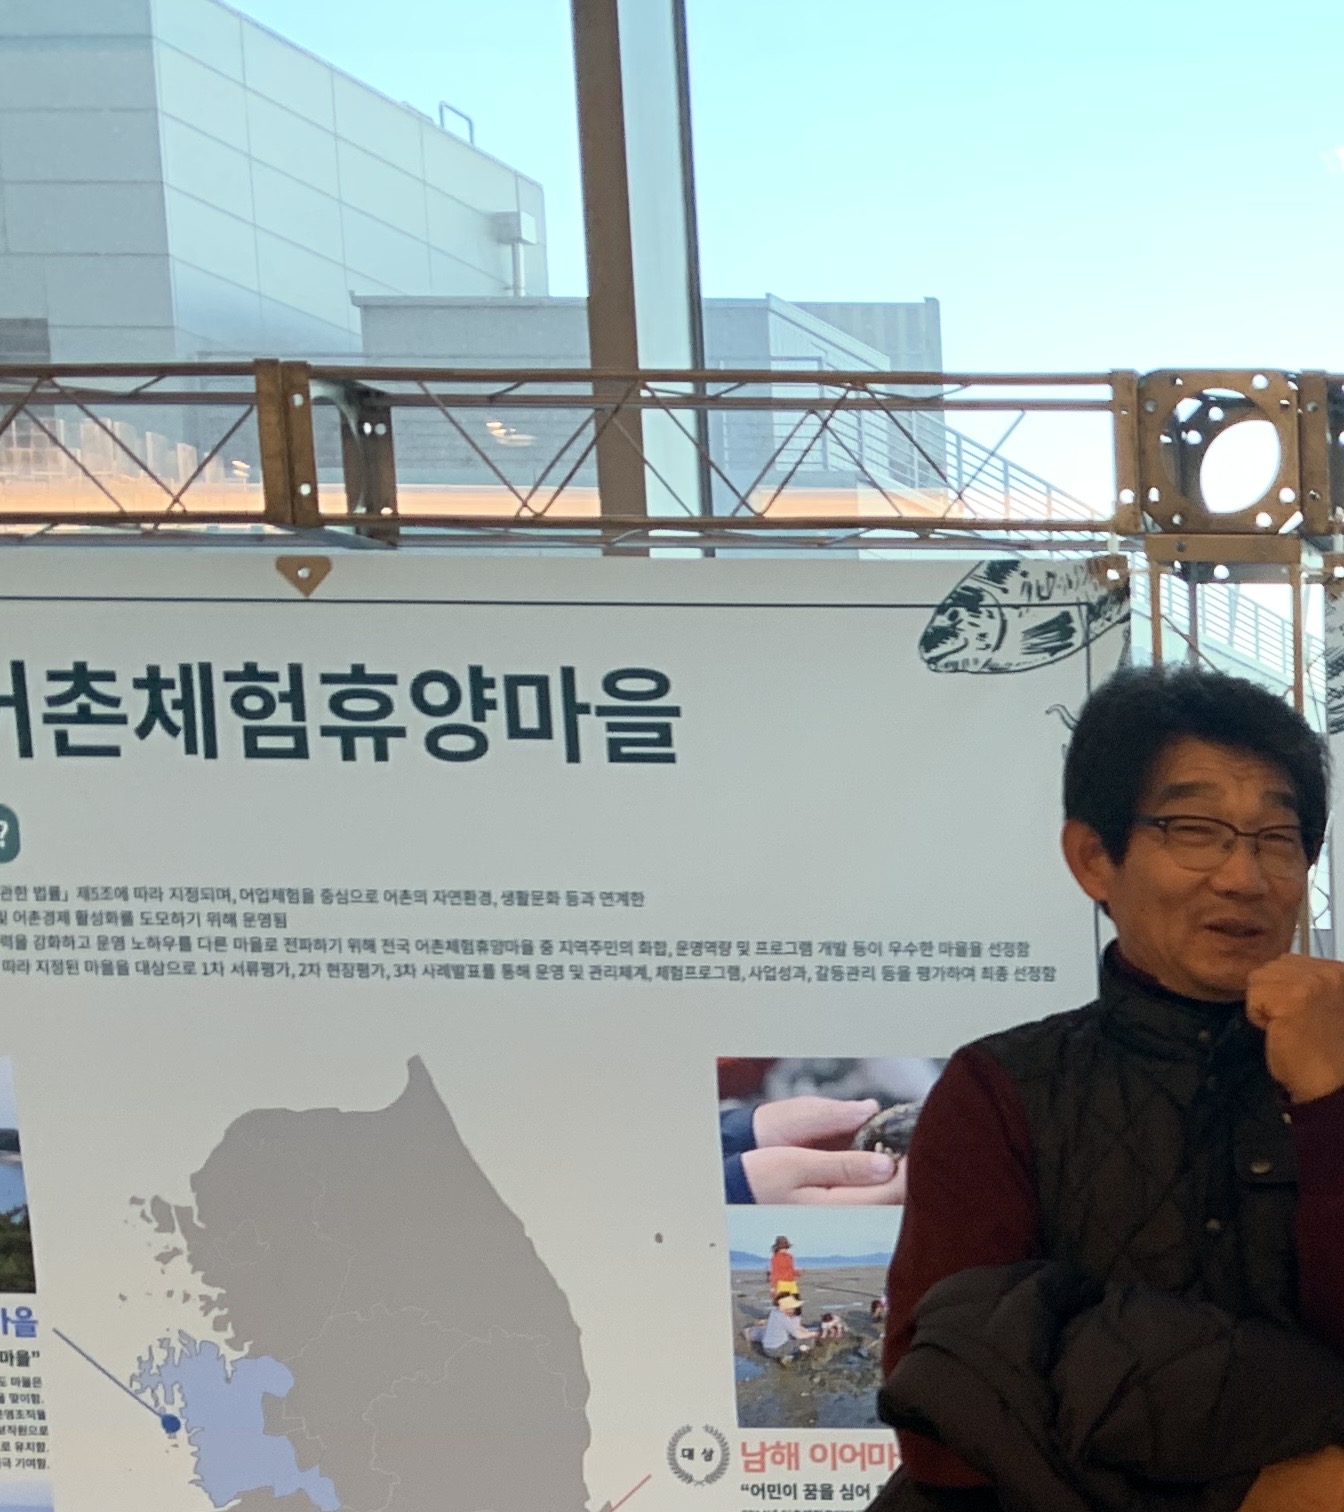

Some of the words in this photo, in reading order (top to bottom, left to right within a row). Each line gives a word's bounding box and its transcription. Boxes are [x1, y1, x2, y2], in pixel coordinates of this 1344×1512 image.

[740, 1442, 799, 1473] 남해
[809, 1442, 898, 1471] 이어마
[803, 1483, 834, 1500] 꿈을
[839, 1483, 871, 1500] 심어
